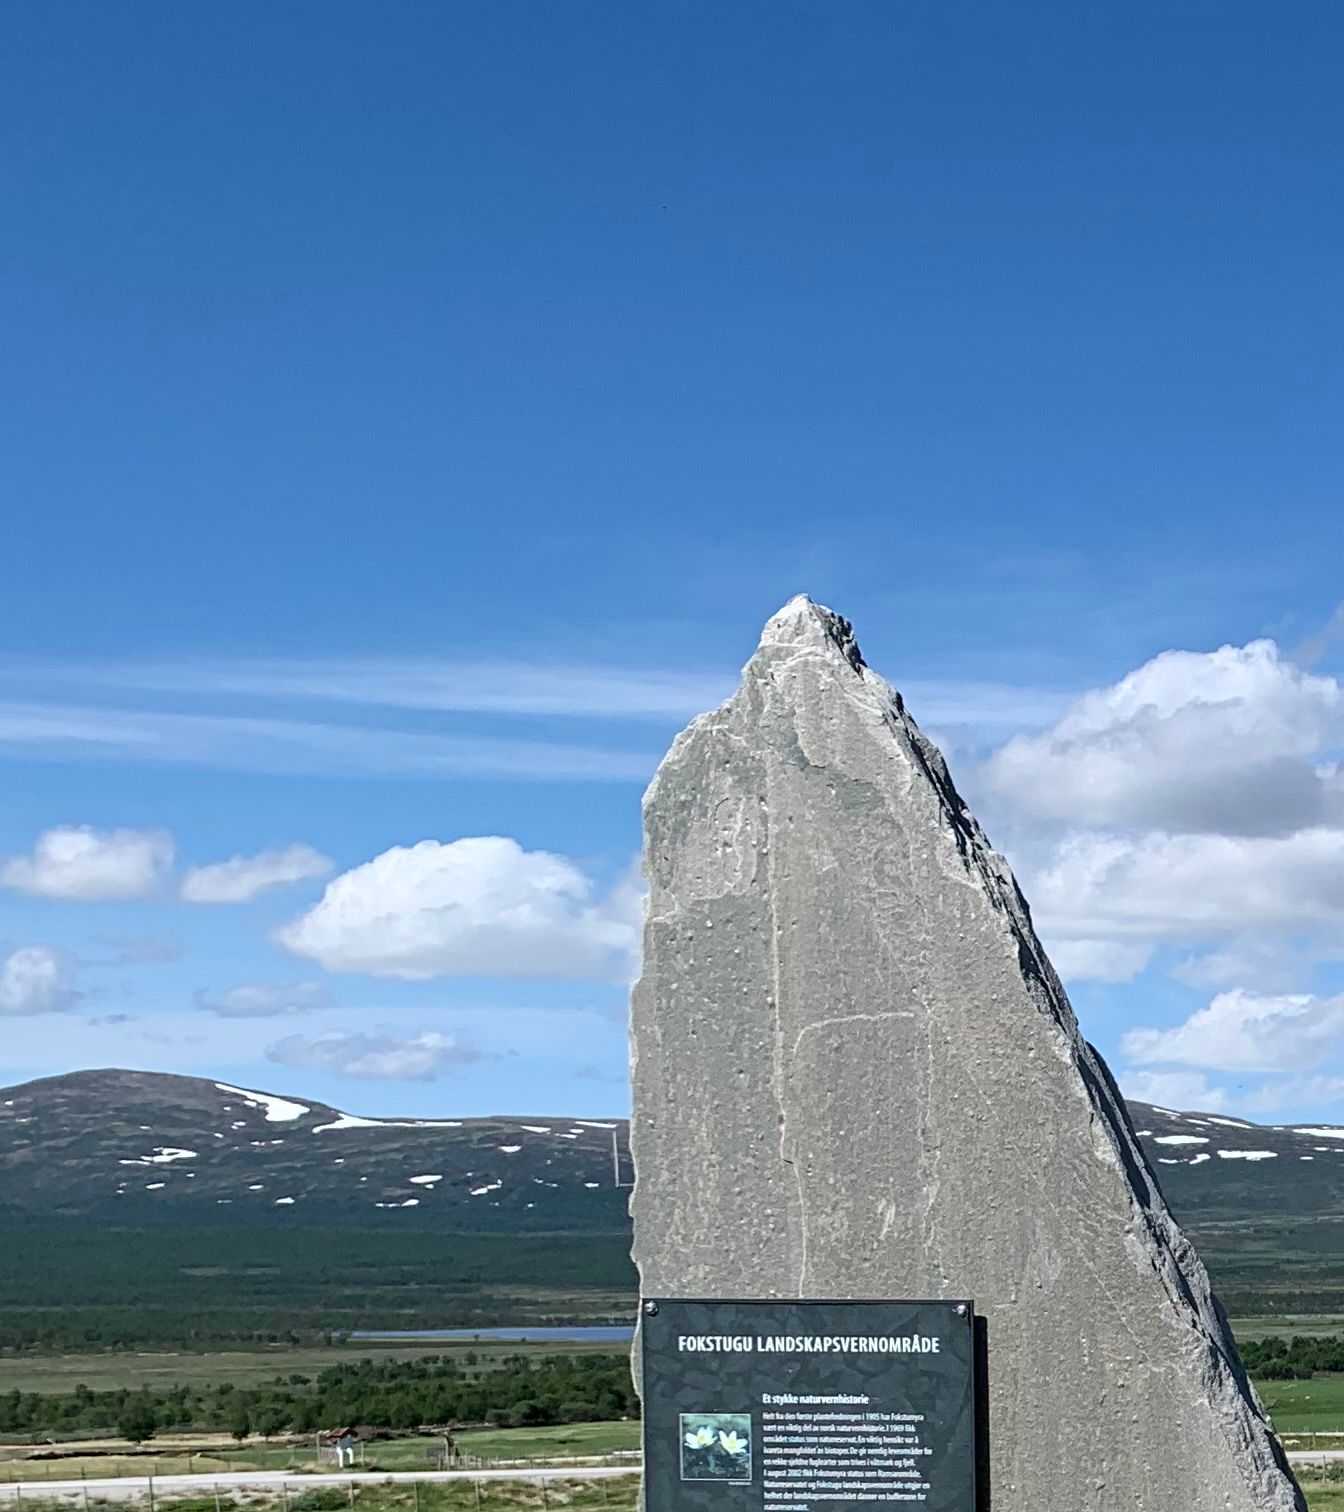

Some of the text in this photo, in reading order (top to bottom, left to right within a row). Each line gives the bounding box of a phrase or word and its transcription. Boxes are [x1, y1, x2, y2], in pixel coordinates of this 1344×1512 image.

[679, 1334, 940, 1353] FOKSTUGU LANDSKAPSVERNOMRÅDE
[763, 1394, 869, 1406] Et stykke naturvernhistorie
